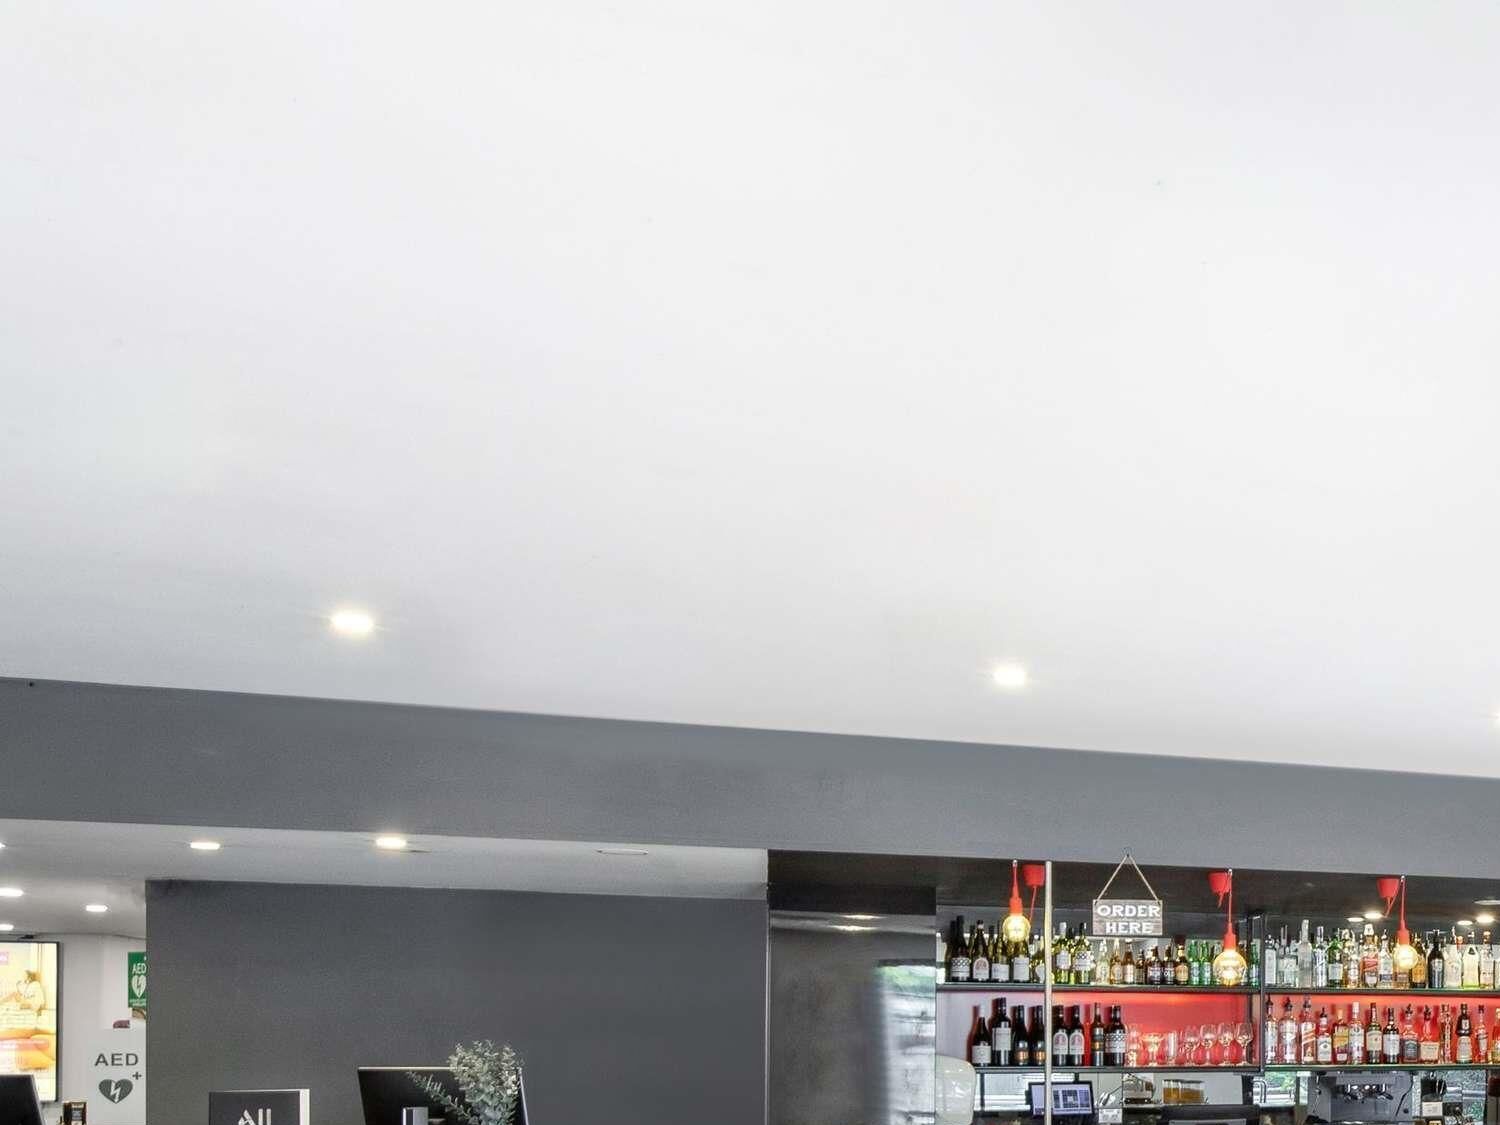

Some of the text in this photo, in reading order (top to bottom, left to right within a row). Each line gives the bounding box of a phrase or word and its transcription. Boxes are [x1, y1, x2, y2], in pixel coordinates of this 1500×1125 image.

[1097, 904, 1160, 917] ORDER
[1105, 922, 1153, 934] HERE
[132, 962, 147, 975] AED
[94, 1053, 139, 1067] AED
